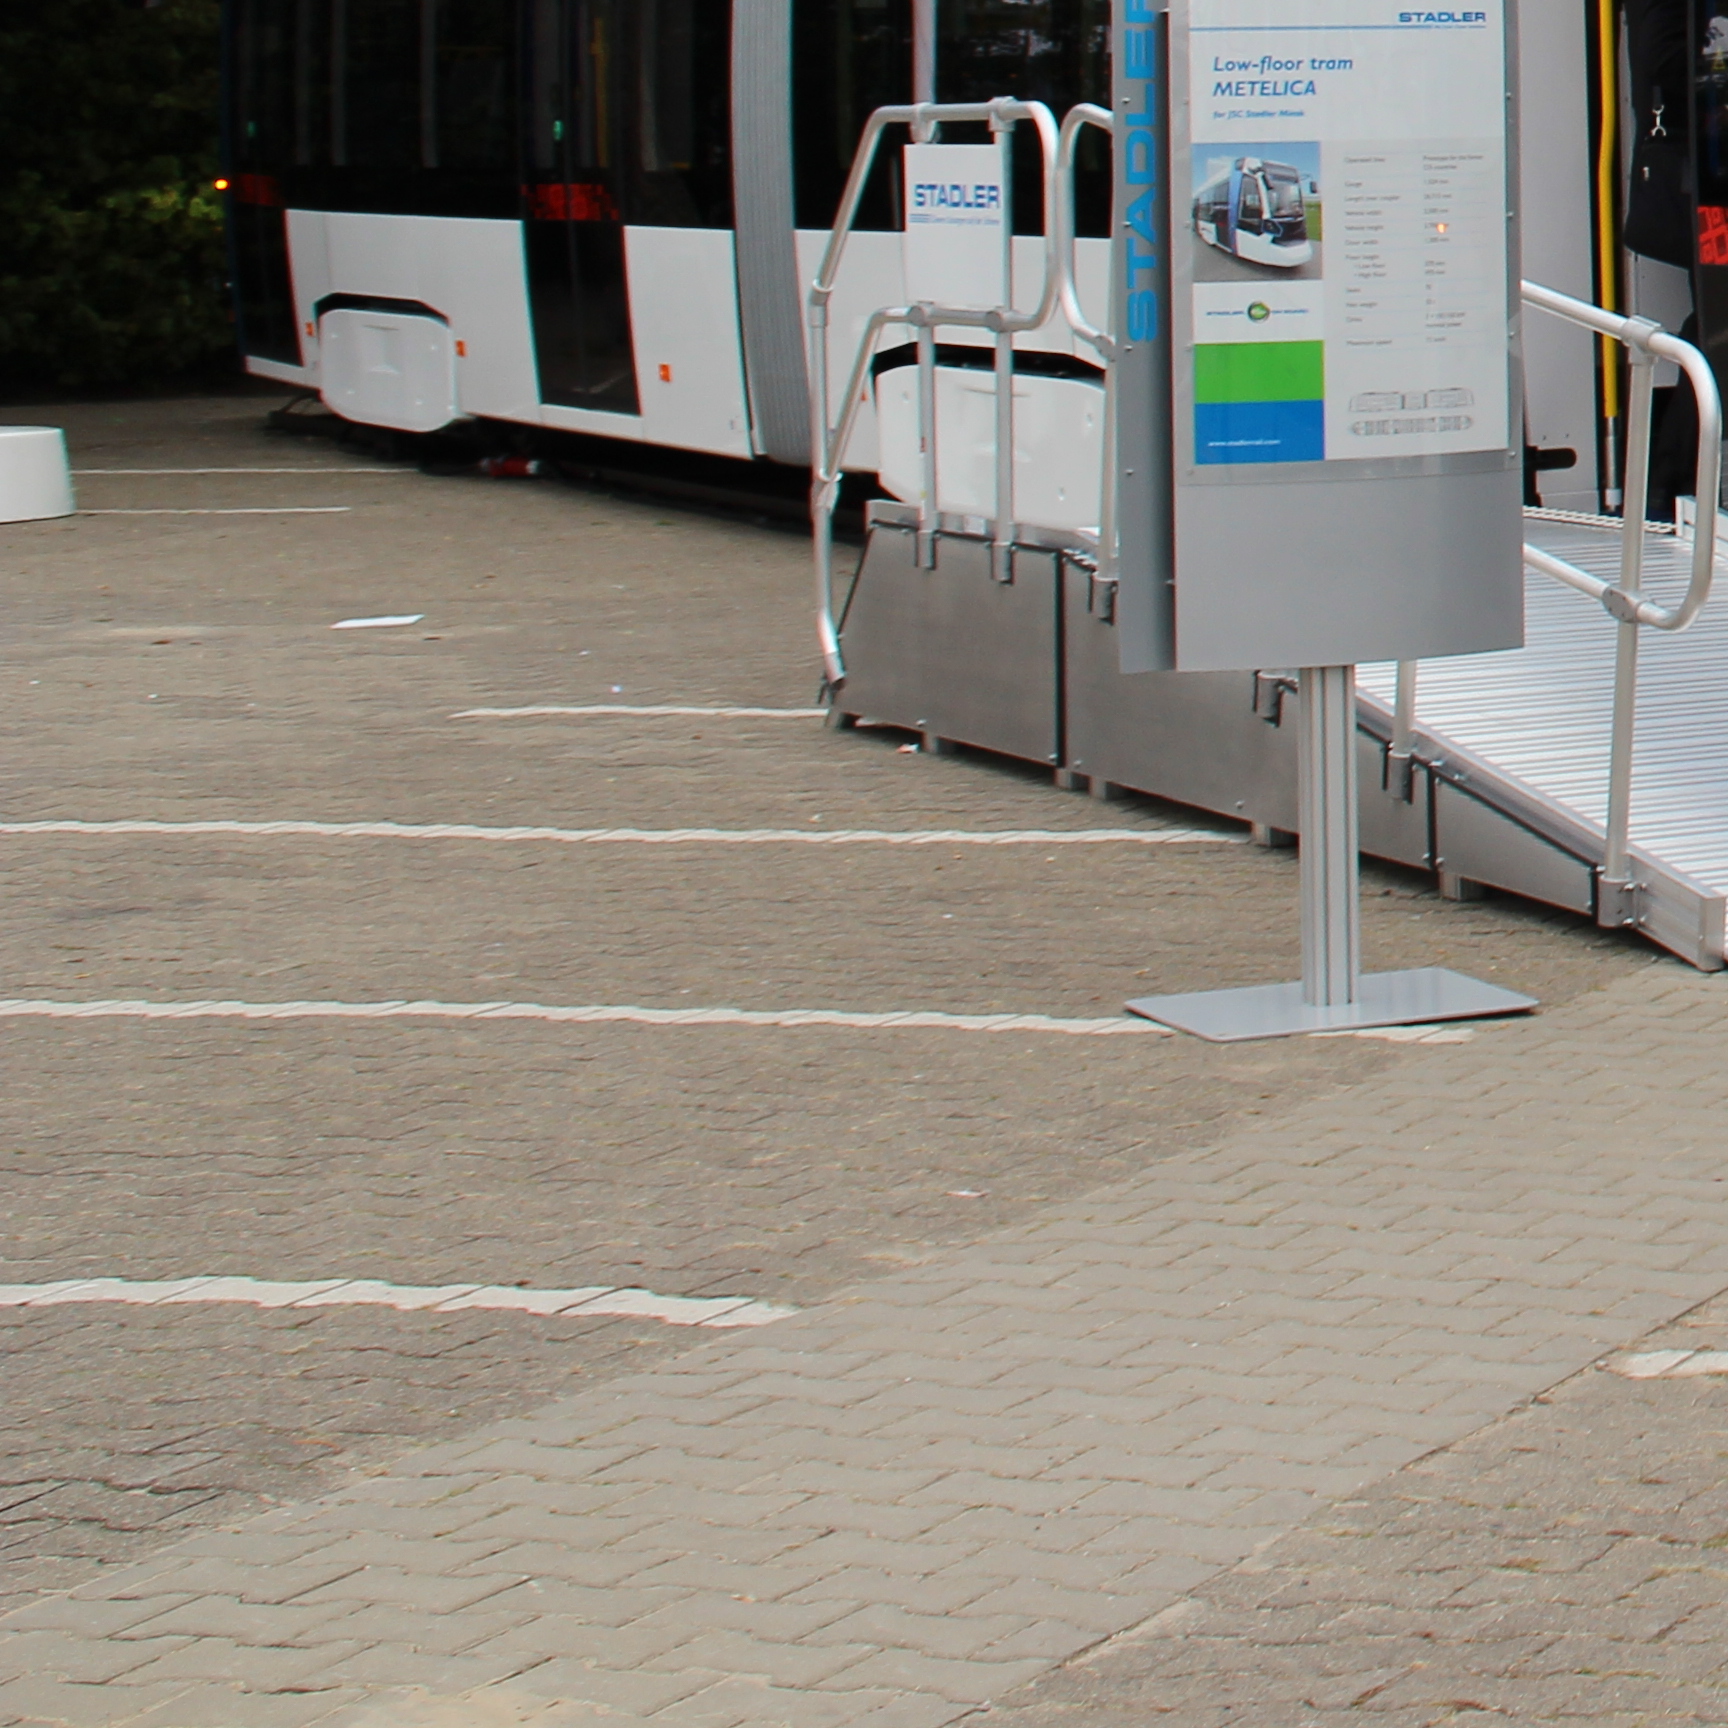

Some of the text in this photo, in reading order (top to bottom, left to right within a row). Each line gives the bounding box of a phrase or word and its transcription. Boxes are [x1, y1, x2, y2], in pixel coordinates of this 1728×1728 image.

[1398, 12, 1486, 23] STADLER
[1213, 55, 1354, 75] Low-floor tram
[1212, 79, 1317, 97] METELICA
[914, 183, 1000, 209] STADLER
